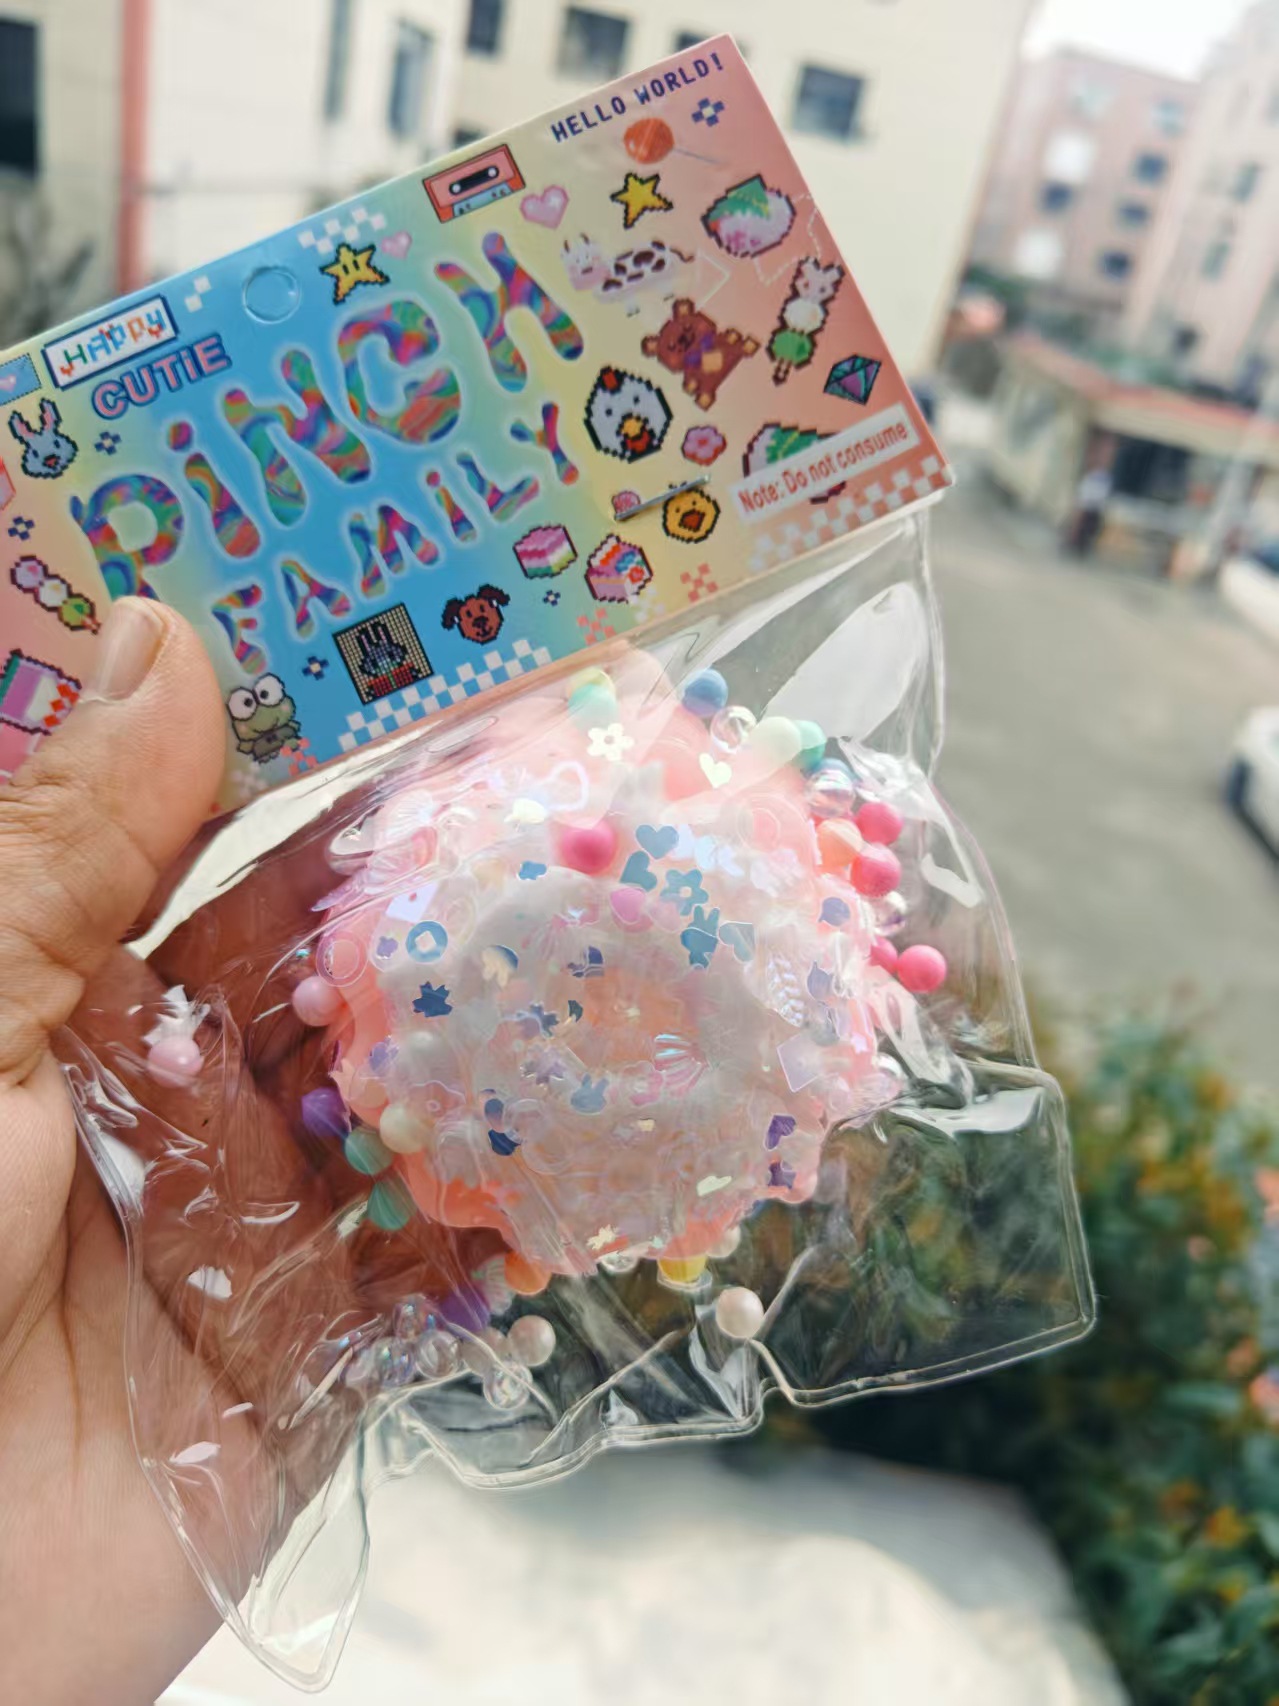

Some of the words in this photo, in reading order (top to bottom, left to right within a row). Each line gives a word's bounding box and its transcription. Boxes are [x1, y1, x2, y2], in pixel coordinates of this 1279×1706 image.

[551, 96, 626, 142] HELLO
[634, 53, 723, 105] WORLD!
[738, 479, 785, 512] Note:
[782, 470, 807, 494] Do
[808, 455, 836, 480] not
[838, 422, 908, 469] consume
